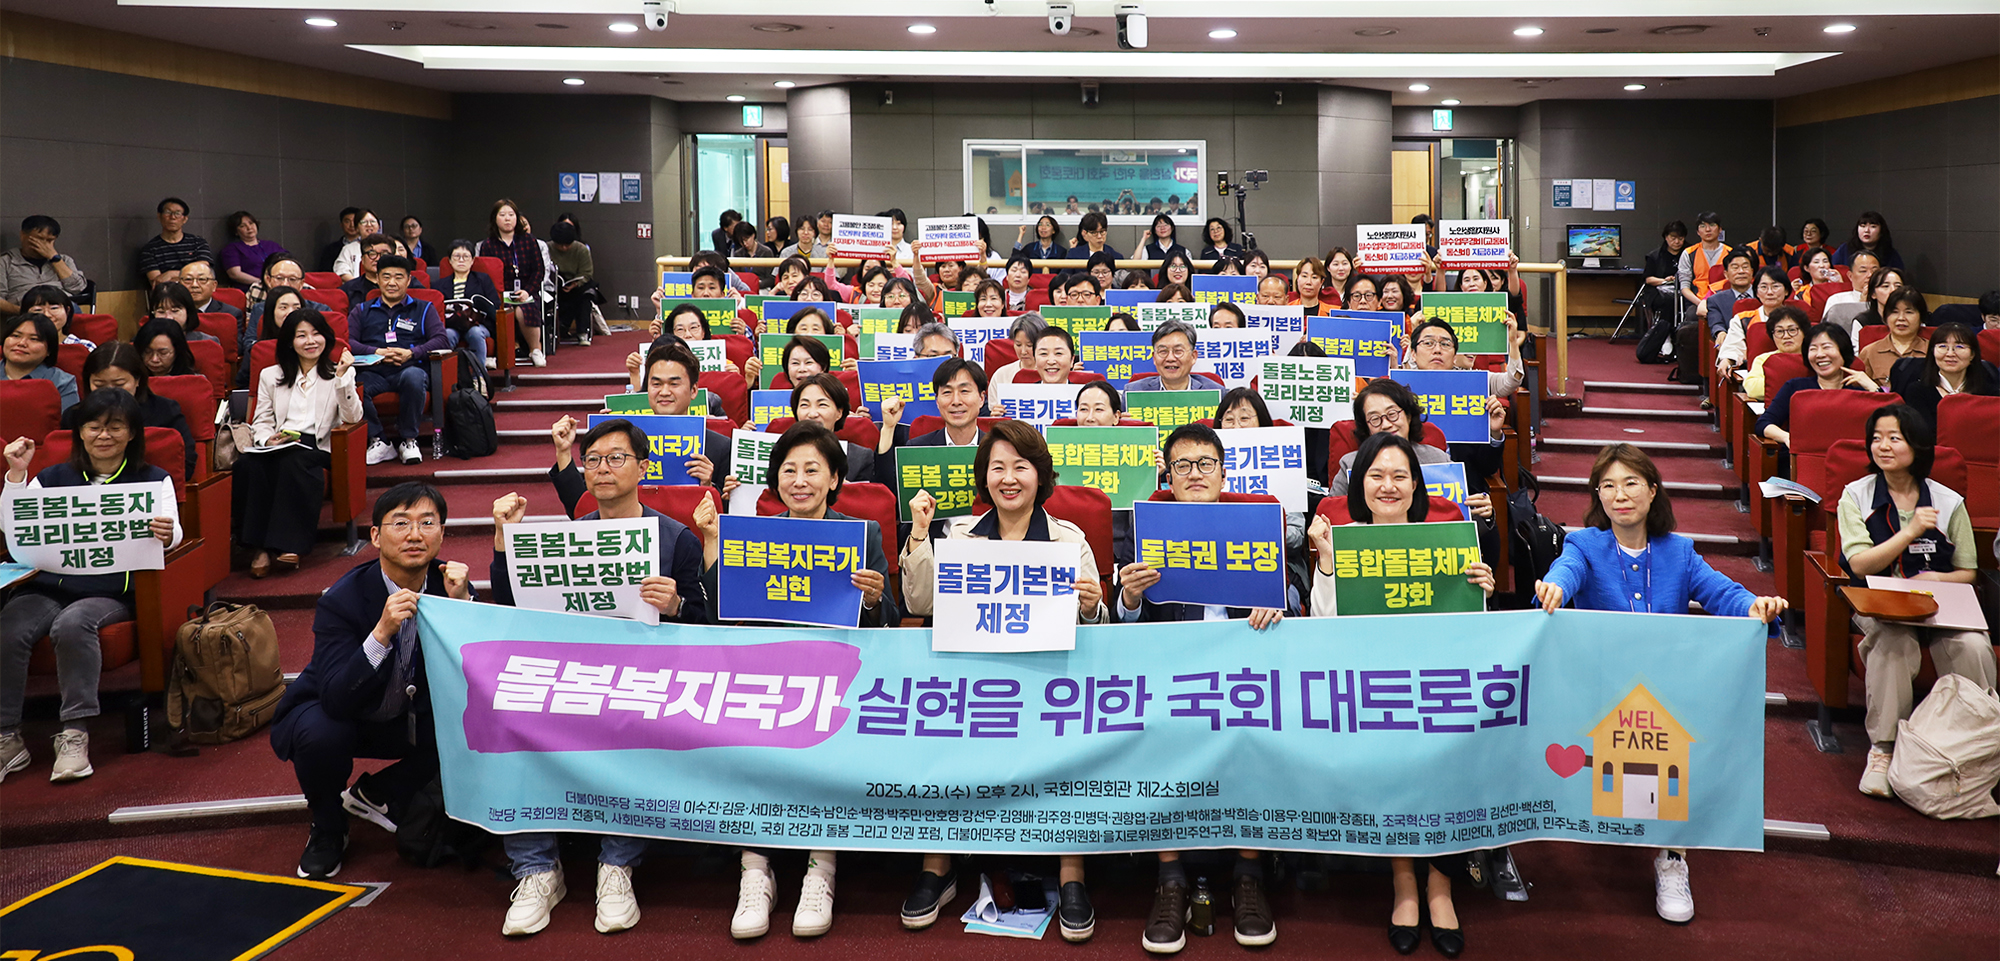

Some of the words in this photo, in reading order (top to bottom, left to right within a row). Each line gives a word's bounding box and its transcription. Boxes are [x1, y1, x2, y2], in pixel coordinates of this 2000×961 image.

[1106, 364, 1132, 380] 실현
[1263, 363, 1350, 382] 돌봄노동자
[863, 382, 914, 403] 돌봄권
[1263, 384, 1350, 403] 권리보장법
[1290, 405, 1323, 423] 제정
[1451, 395, 1486, 416] 보장
[1047, 443, 1157, 467] 통합돌봄체계
[902, 465, 942, 488] 돌봄
[1083, 471, 1120, 494] 강화
[1228, 475, 1268, 495] 제정
[12, 491, 154, 520] 돌봄노동자
[14, 519, 155, 546] 권리보장법
[513, 528, 651, 558] 돌봄노동자
[60, 546, 114, 568] 제정
[723, 539, 860, 573] 돌봄복지국가
[1141, 538, 1218, 570] 돌봄권
[1226, 541, 1279, 572] 보장
[1335, 546, 1480, 578] 통합돌봄체계
[516, 561, 650, 587] 권리보장법
[938, 563, 1075, 596] 돌봄기본법
[766, 574, 811, 602] 실현
[1384, 582, 1434, 609] 강화
[562, 591, 617, 612] 제정
[976, 603, 1030, 633] 제정
[492, 655, 842, 732] 돌봄복지국가
[857, 676, 1023, 738] 실현을
[1040, 675, 1153, 737] 위한
[1167, 667, 1282, 731] 국회
[1300, 664, 1531, 733] 대토론회
[1618, 709, 1663, 731] WEL
[1612, 731, 1669, 752] FARE
[866, 782, 970, 799] 2025.4.23.(수)
[976, 785, 1006, 799] 오후
[1011, 783, 1039, 798] 2시,
[1044, 780, 1132, 798] 국회의원회관
[1137, 780, 1219, 798] 제2소회의실
[566, 791, 631, 810] 더불어민주당
[634, 798, 681, 814] 국회의원
[1382, 813, 1441, 828] 조국혁신당
[1444, 807, 1487, 824] 국회의원
[520, 806, 568, 821] 국회의원
[571, 807, 608, 824] 전종덕,
[611, 812, 666, 829] 사회민주당
[669, 817, 716, 833] 국회의원
[719, 820, 757, 836] 한창민,
[761, 821, 784, 836] 국회
[788, 822, 823, 838] 건강과
[826, 823, 849, 838] 돌봄
[852, 824, 887, 839] 그리고
[891, 825, 914, 840] 인권
[917, 826, 944, 842] 포럼,
[947, 827, 1015, 843] 더불어민주당
[1240, 825, 1263, 838] 돌봄
[1267, 826, 1303, 841] 공공성
[1306, 827, 1341, 842] 확보와
[1345, 829, 1381, 845] 돌봄권
[1385, 831, 1420, 845] 실현을
[1424, 831, 1447, 845] 위한
[1450, 825, 1495, 843] 시민연대,
[1497, 818, 1540, 837] 참여연대,
[1543, 816, 1594, 834] 민주노총,
[1598, 820, 1646, 836] 한국노총
